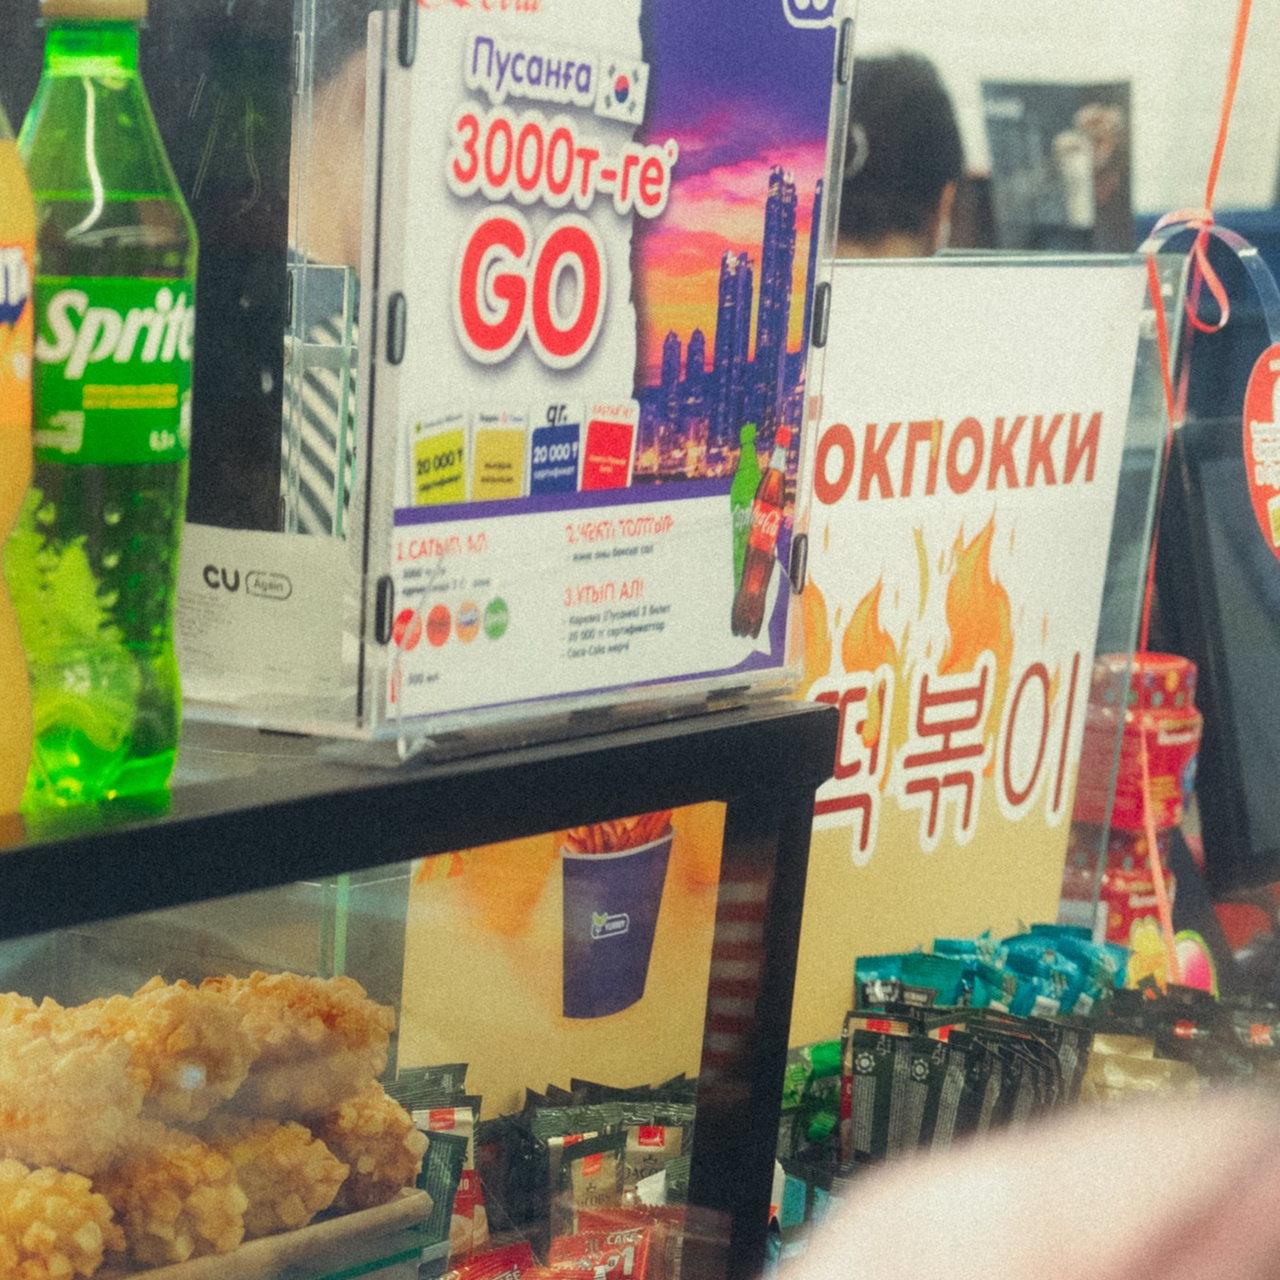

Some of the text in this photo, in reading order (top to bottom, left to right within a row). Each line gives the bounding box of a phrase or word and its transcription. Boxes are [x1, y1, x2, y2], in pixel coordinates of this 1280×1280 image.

[472, 36, 592, 93] Пусанға
[459, 217, 601, 358] GO
[814, 412, 1102, 505] ОКПОККИ
[203, 564, 240, 592] CU
